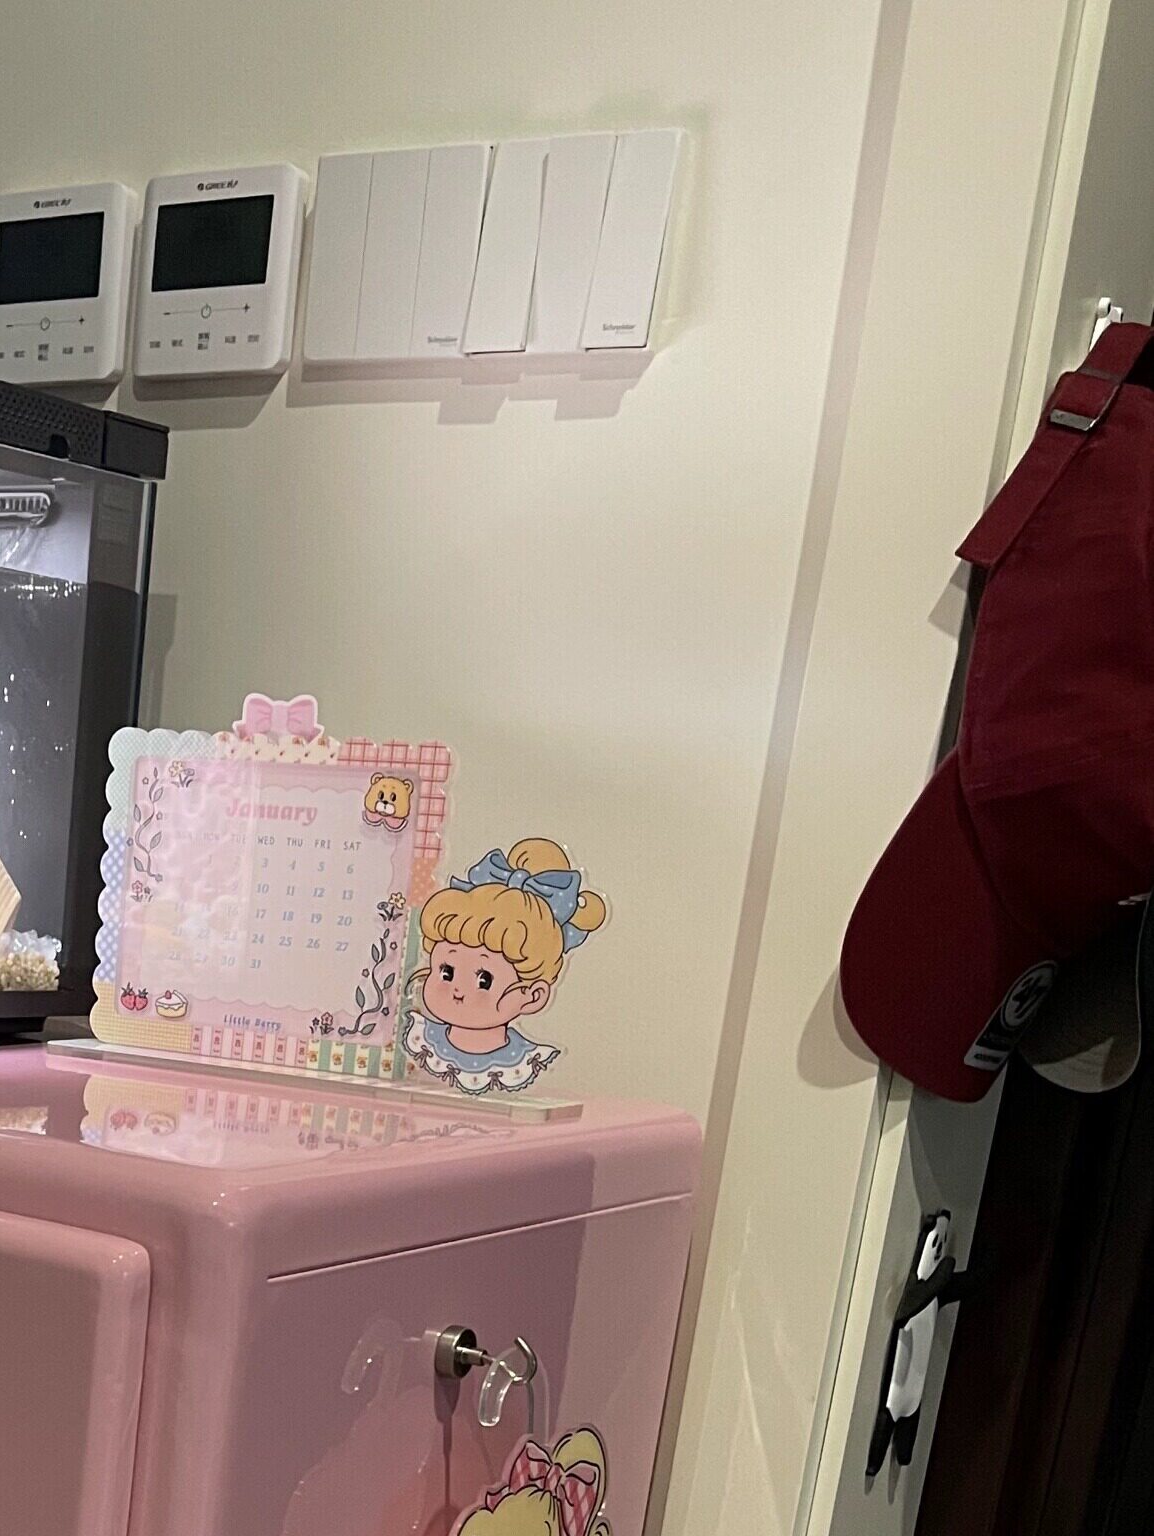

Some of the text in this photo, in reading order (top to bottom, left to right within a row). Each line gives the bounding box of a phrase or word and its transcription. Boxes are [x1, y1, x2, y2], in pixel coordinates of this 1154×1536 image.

[225, 799, 318, 826] January
[232, 834, 246, 844] TUE
[257, 836, 275, 845] WED
[287, 838, 303, 847] THU
[314, 839, 331, 849] FRI
[343, 841, 362, 851] SAT
[262, 858, 269, 868] 3
[318, 862, 325, 872] 5
[347, 864, 354, 874] 6
[257, 884, 269, 893] 10
[286, 886, 295, 896] 11
[312, 888, 325, 898] 12
[342, 890, 353, 901] 13
[256, 909, 266, 919] 17
[282, 911, 294, 921] 18
[310, 914, 322, 924] 19
[337, 915, 352, 926] 20
[252, 934, 264, 944] 24
[279, 936, 292, 947] 25
[306, 939, 320, 949] 26
[335, 942, 349, 952] 27
[222, 956, 235, 966] 30
[250, 959, 261, 969] 31
[224, 1014, 251, 1027] Little
